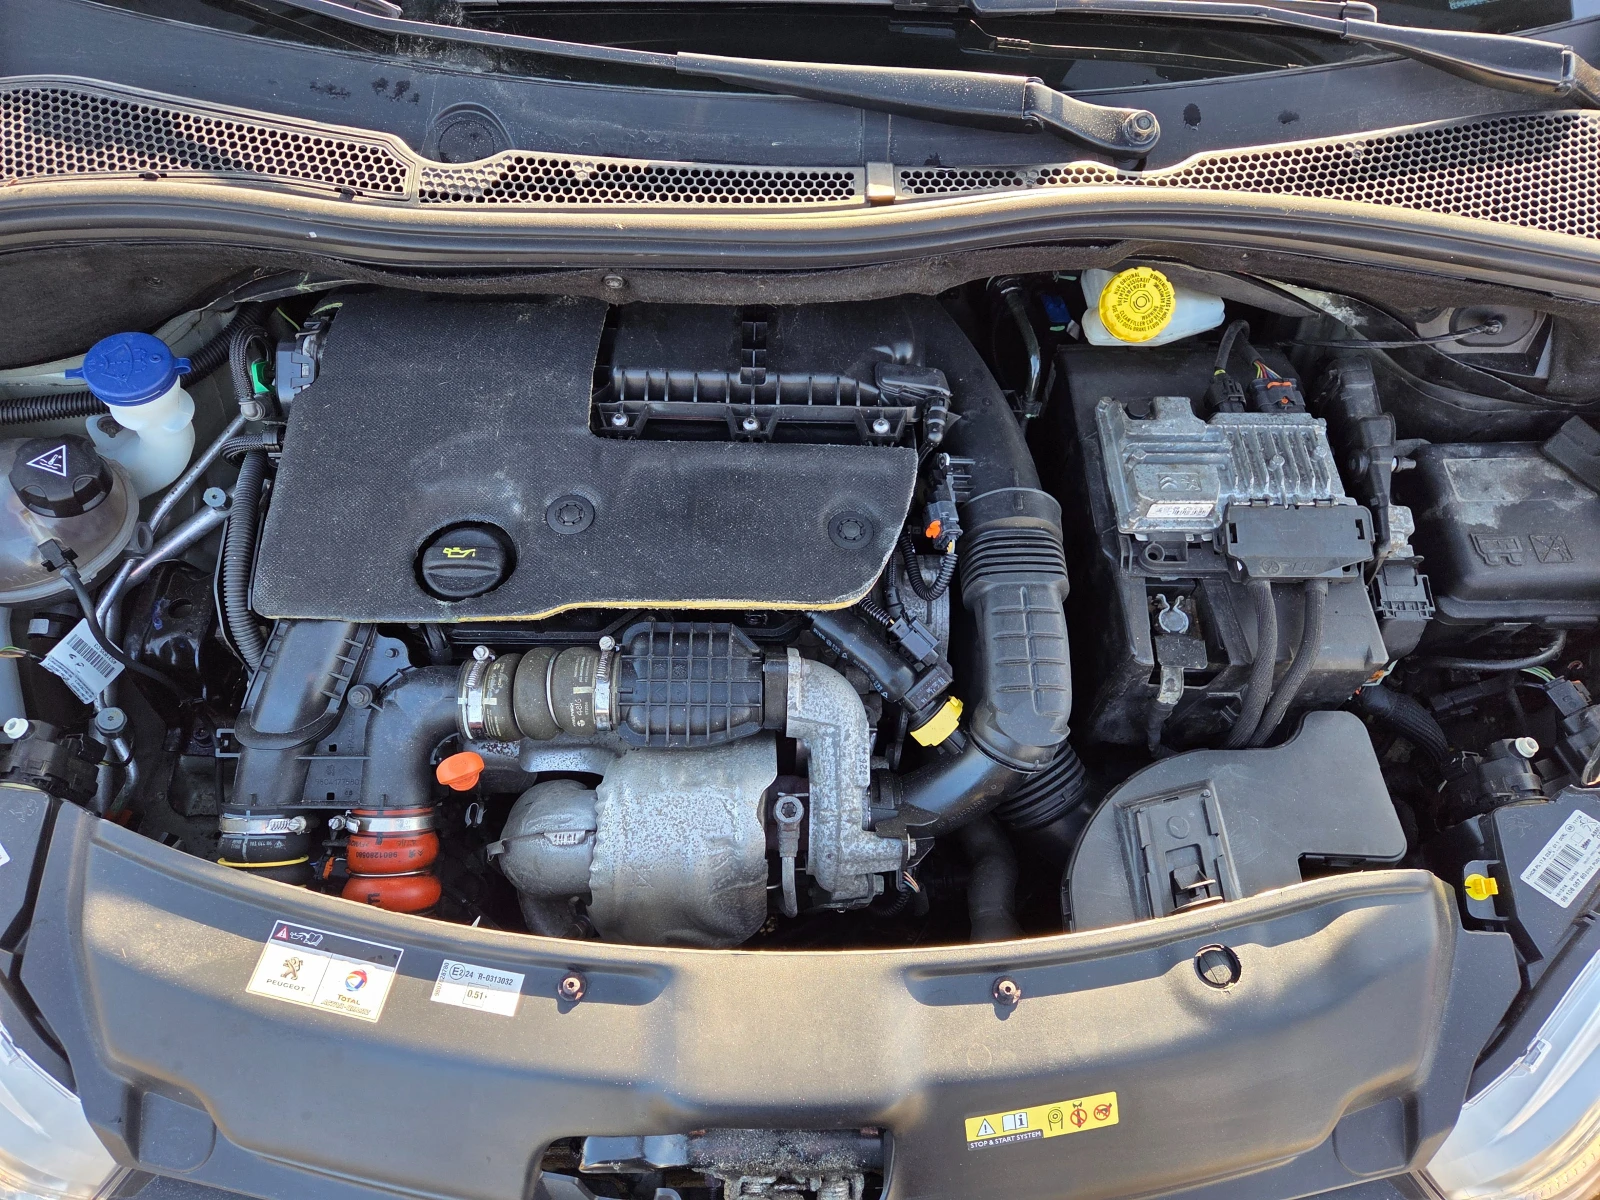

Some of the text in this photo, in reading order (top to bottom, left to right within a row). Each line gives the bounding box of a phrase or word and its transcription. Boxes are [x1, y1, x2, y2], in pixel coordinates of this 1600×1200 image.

[1120, 272, 1140, 284] ORIGINAL
[1150, 273, 1169, 292] CONTAINER
[1120, 311, 1131, 322] CLEAN
[1154, 304, 1165, 320] BEFORE
[1142, 306, 1159, 320] WARNING
[1159, 311, 1168, 324] FROM
[1122, 322, 1132, 330] DOT4
[1147, 322, 1160, 330] FLUID
[266, 979, 305, 991] PEUGEOT
[338, 994, 360, 1005] TOTAL
[467, 990, 483, 999] 0.51
[995, 1136, 1015, 1144] START
[1017, 1131, 1041, 1140] SYSTEM
